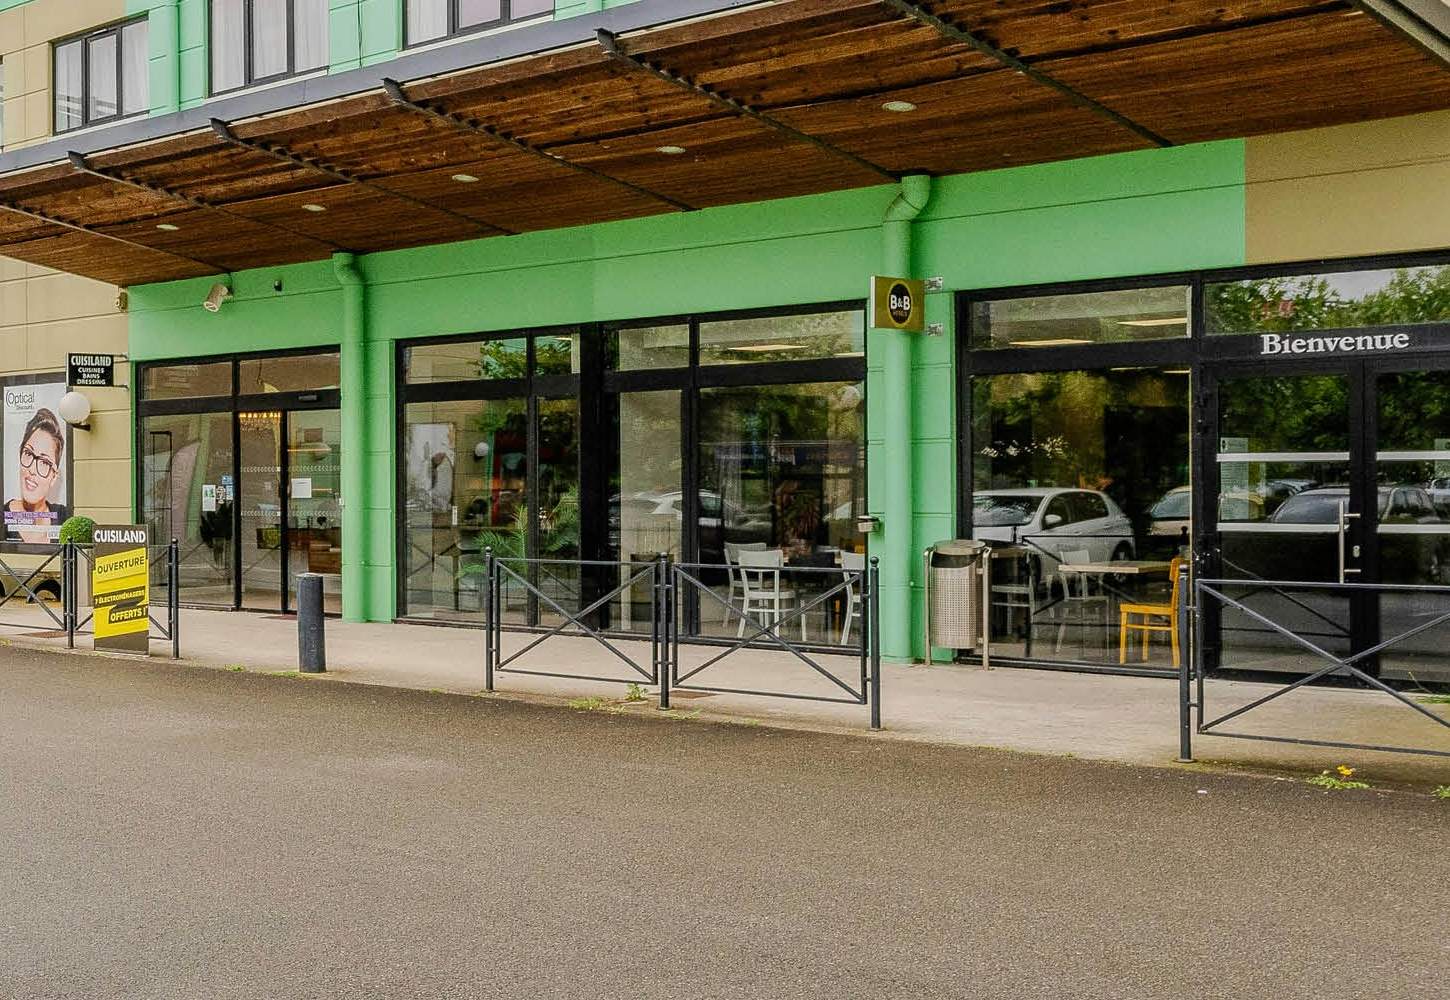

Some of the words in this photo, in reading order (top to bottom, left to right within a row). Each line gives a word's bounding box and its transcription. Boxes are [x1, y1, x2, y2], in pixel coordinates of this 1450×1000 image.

[890, 294, 911, 311] B&B
[1260, 332, 1410, 355] Bienvenue
[70, 355, 112, 367] CUISILAND
[94, 529, 147, 543] CUISILAND
[97, 556, 145, 574] OUVERTURE
[110, 607, 142, 622] OFFERTS
